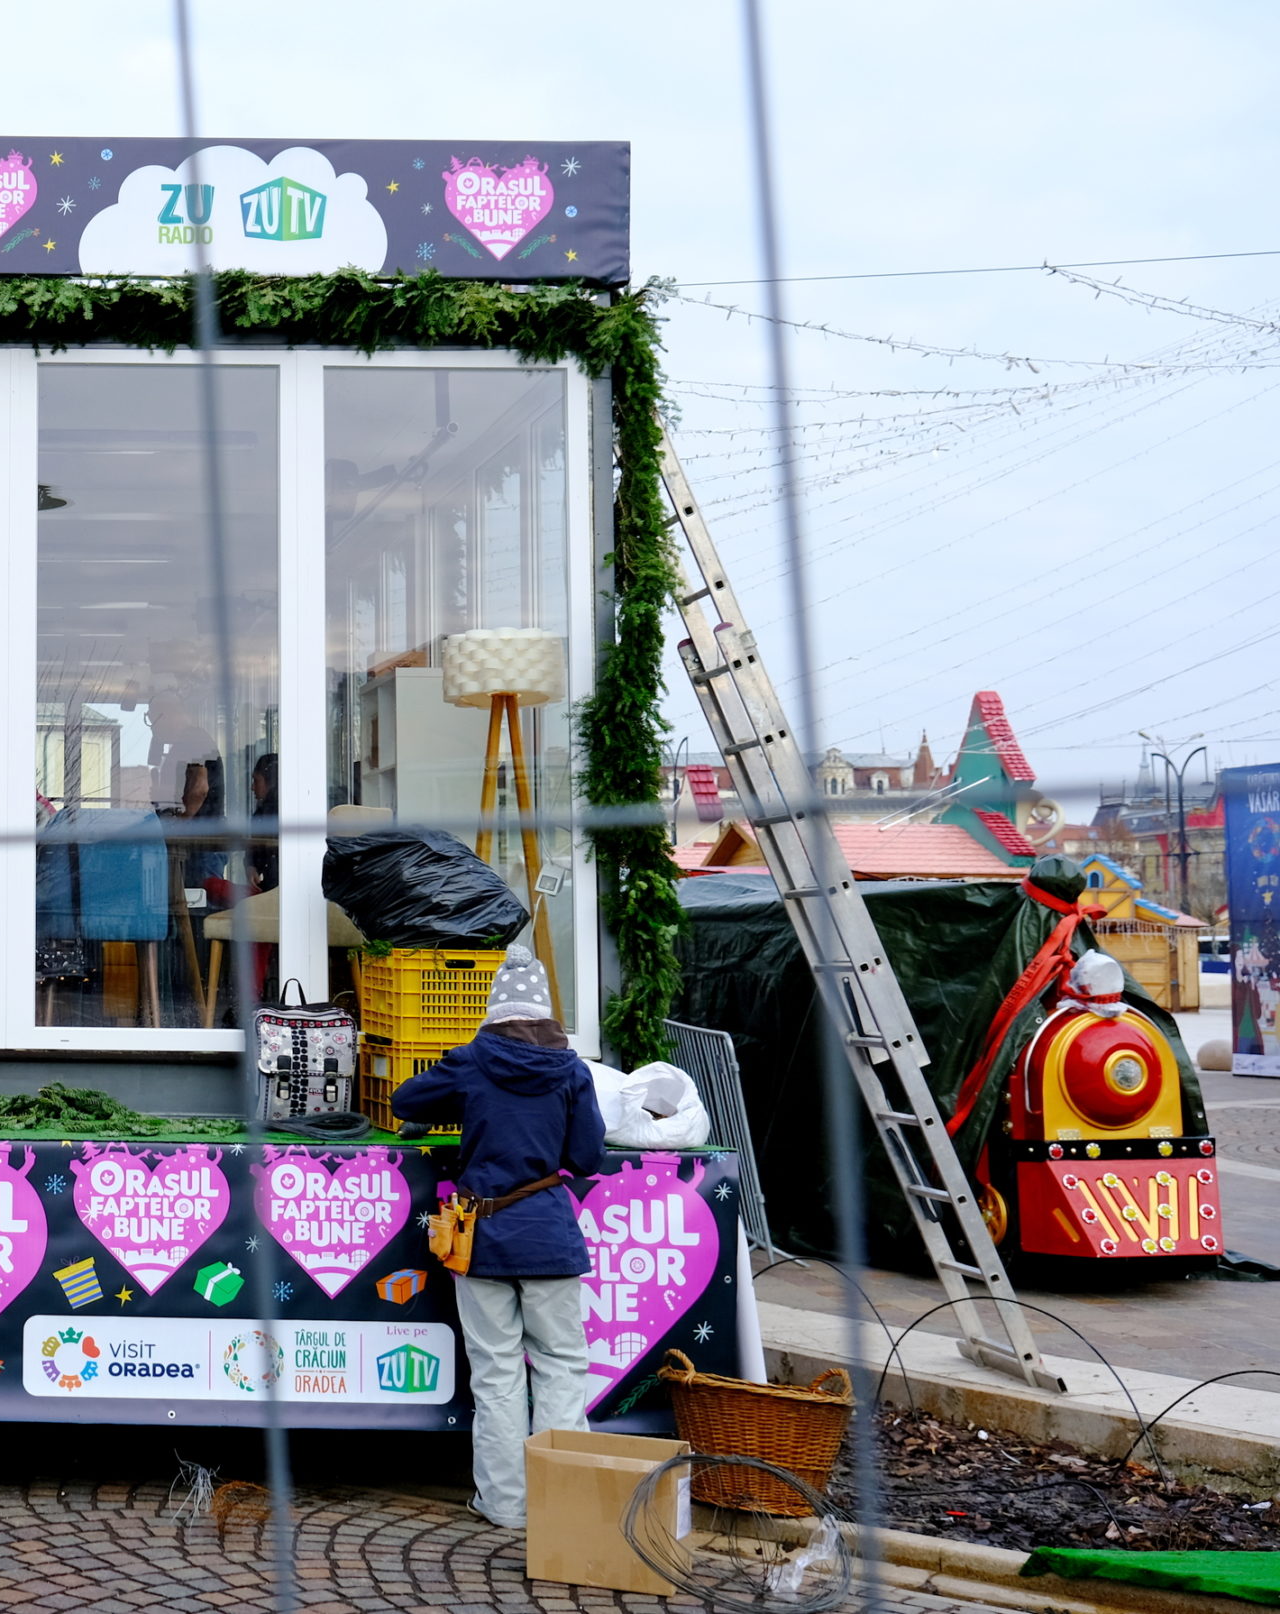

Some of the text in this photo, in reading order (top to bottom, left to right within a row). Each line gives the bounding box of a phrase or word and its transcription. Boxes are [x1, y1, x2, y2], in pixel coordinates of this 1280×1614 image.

[158, 184, 215, 225] ZU
[243, 186, 322, 235] ZU TV
[473, 209, 523, 226] BUNE
[158, 226, 214, 245] RADIO
[114, 1217, 185, 1244] BUNE
[295, 1220, 366, 1247] BUNE
[577, 1193, 700, 1248] AȘUL
[580, 1282, 639, 1323] NE
[295, 1328, 346, 1347] TÂRGUL DE
[386, 1326, 428, 1338] Live pe
[295, 1347, 346, 1368] CRĂCIUN
[378, 1351, 437, 1388] ZU TV
[295, 1375, 347, 1394] ORADEA
